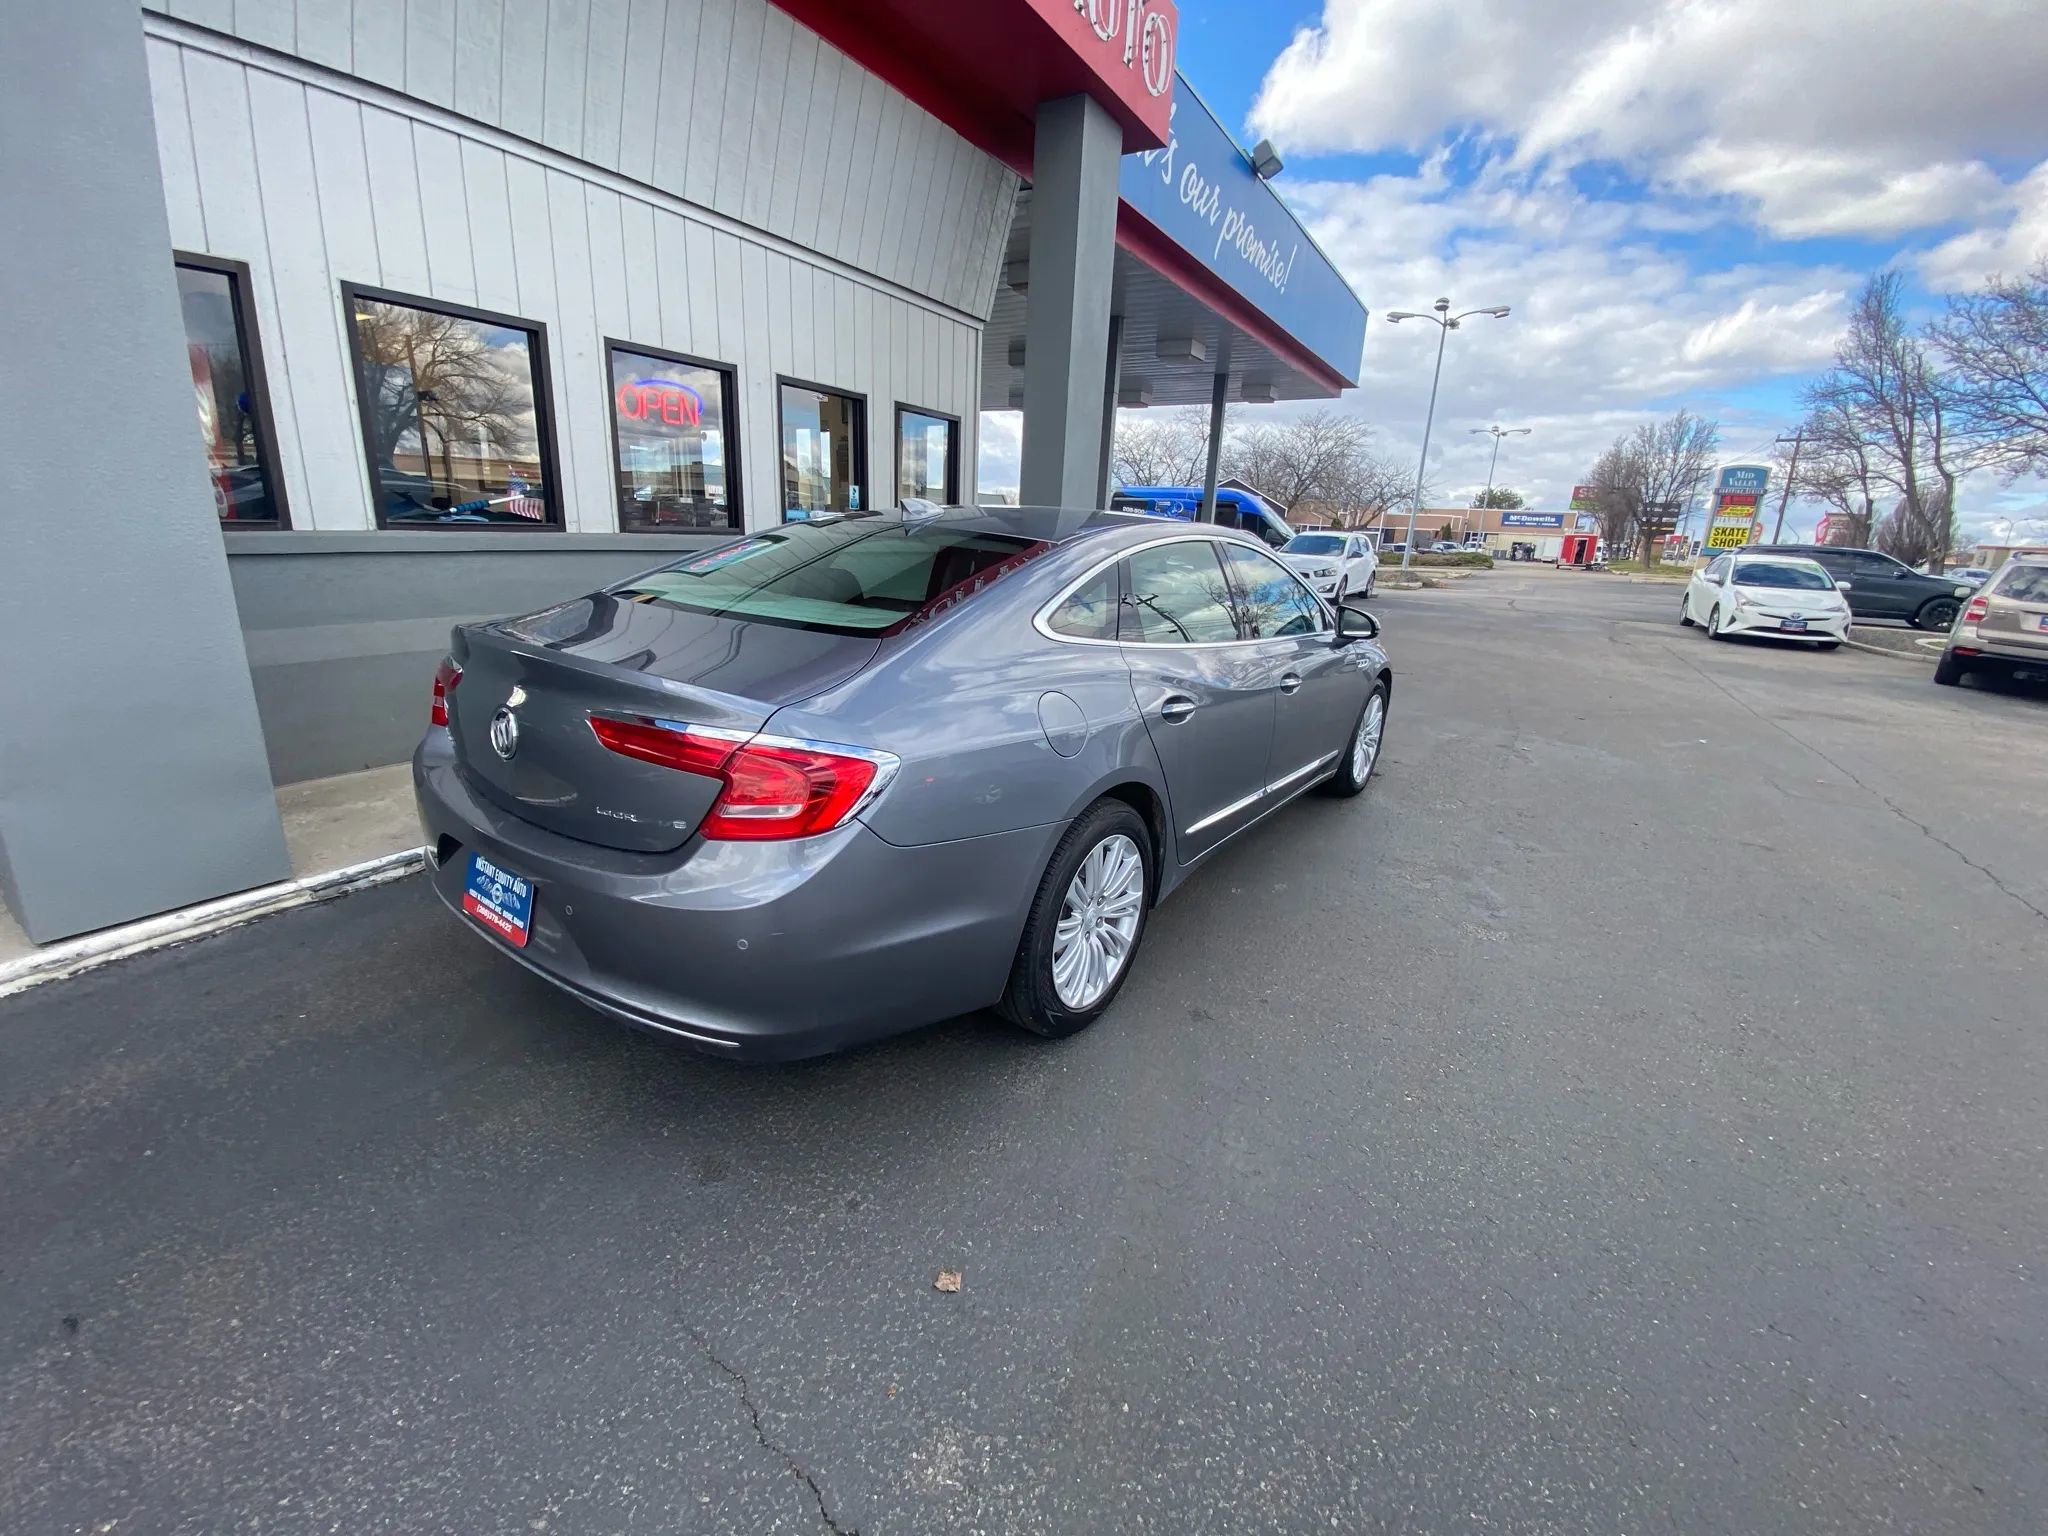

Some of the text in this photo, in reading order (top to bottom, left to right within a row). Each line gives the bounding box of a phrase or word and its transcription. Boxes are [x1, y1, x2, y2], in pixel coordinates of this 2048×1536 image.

[1180, 163, 1221, 227] our
[1214, 207, 1298, 295] promise!
[618, 383, 701, 428] OPEN
[1711, 538, 1742, 548] SHOP
[1712, 527, 1748, 538] SKATE
[476, 856, 496, 878] INSTANT
[495, 869, 515, 889] EQUITY
[512, 879, 527, 898] AUTO
